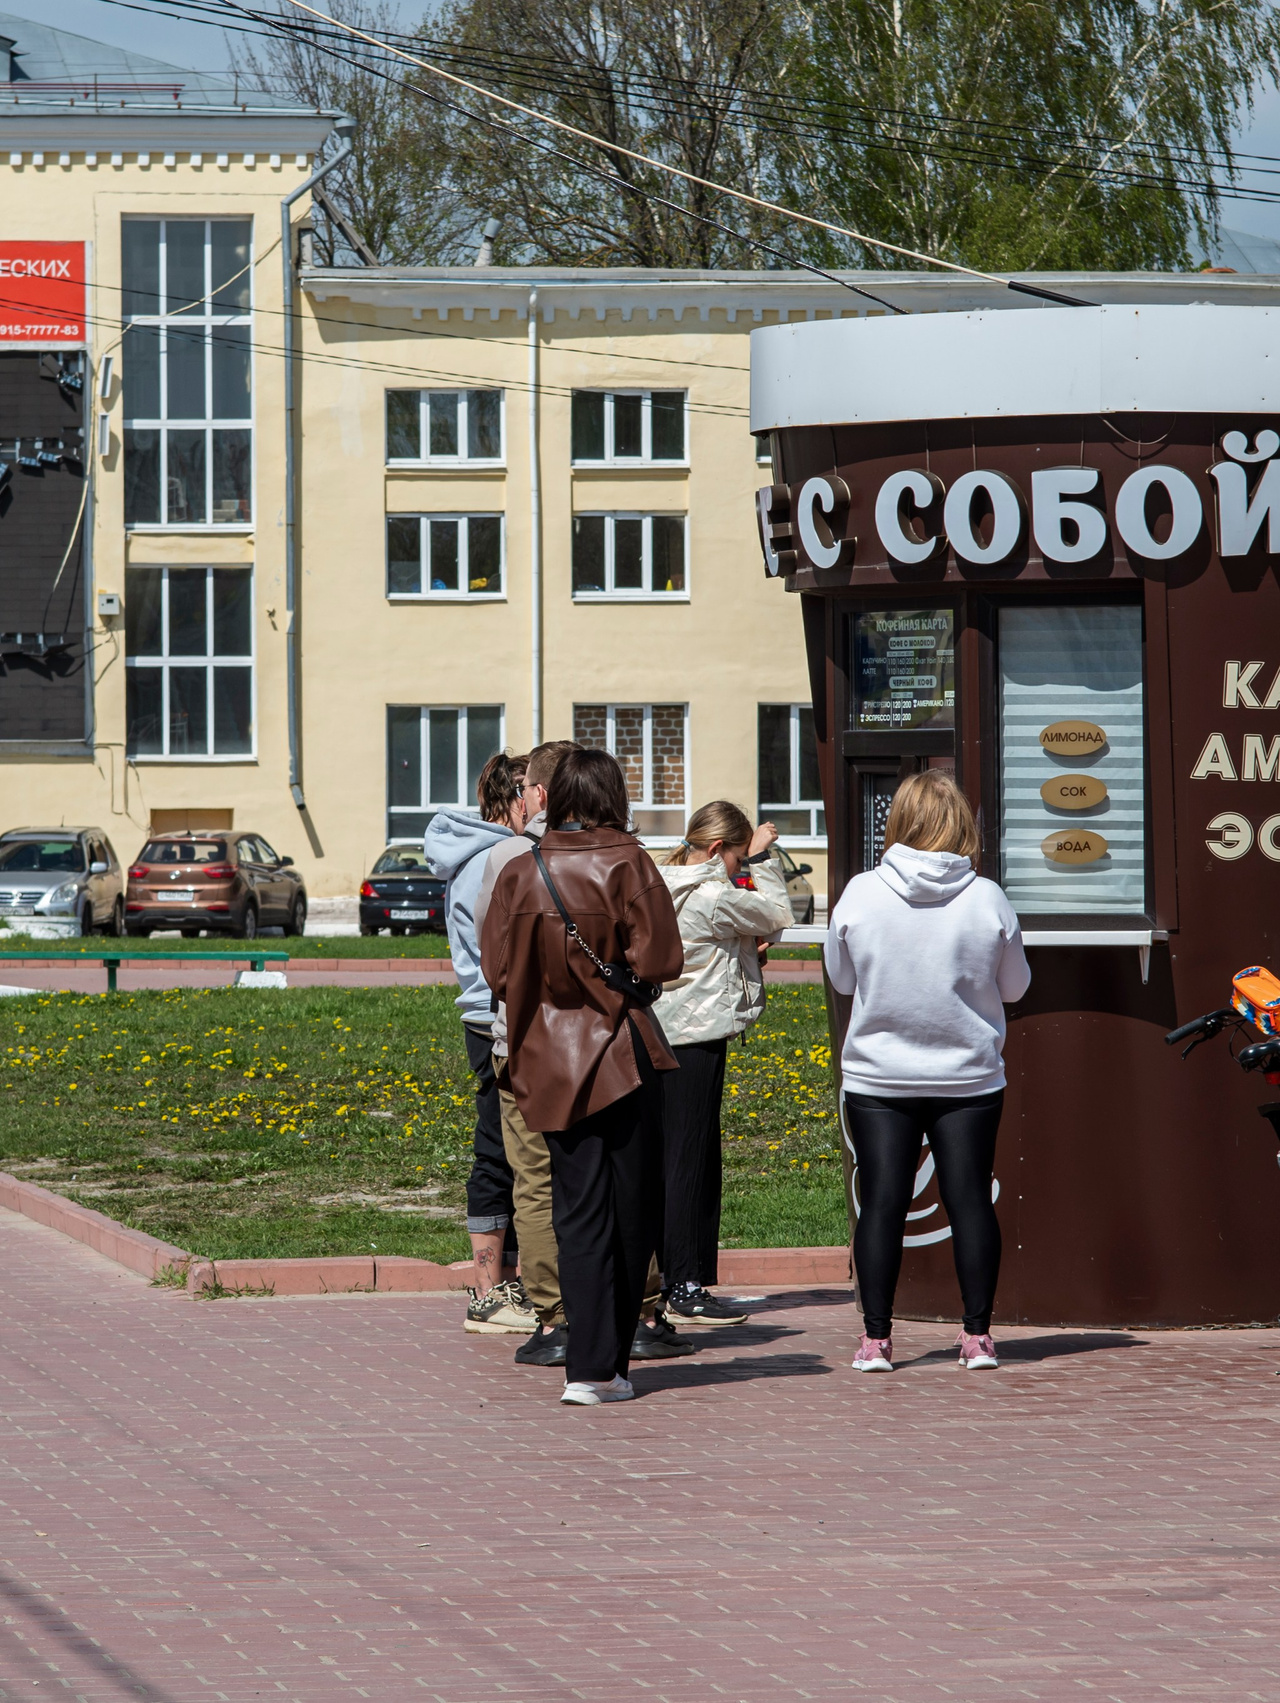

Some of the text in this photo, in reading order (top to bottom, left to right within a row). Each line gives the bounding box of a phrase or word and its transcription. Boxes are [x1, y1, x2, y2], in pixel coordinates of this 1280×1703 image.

[876, 616, 948, 632] КОФЕЙНАЯ КАРТА
[890, 639, 904, 648] КОФЕ
[892, 678, 933, 687] ЧЕРНЫЙ КОФЕ
[1042, 731, 1103, 743] ЛИМОНАД
[1059, 786, 1087, 797] СОК
[1056, 841, 1091, 853] ВОДА
